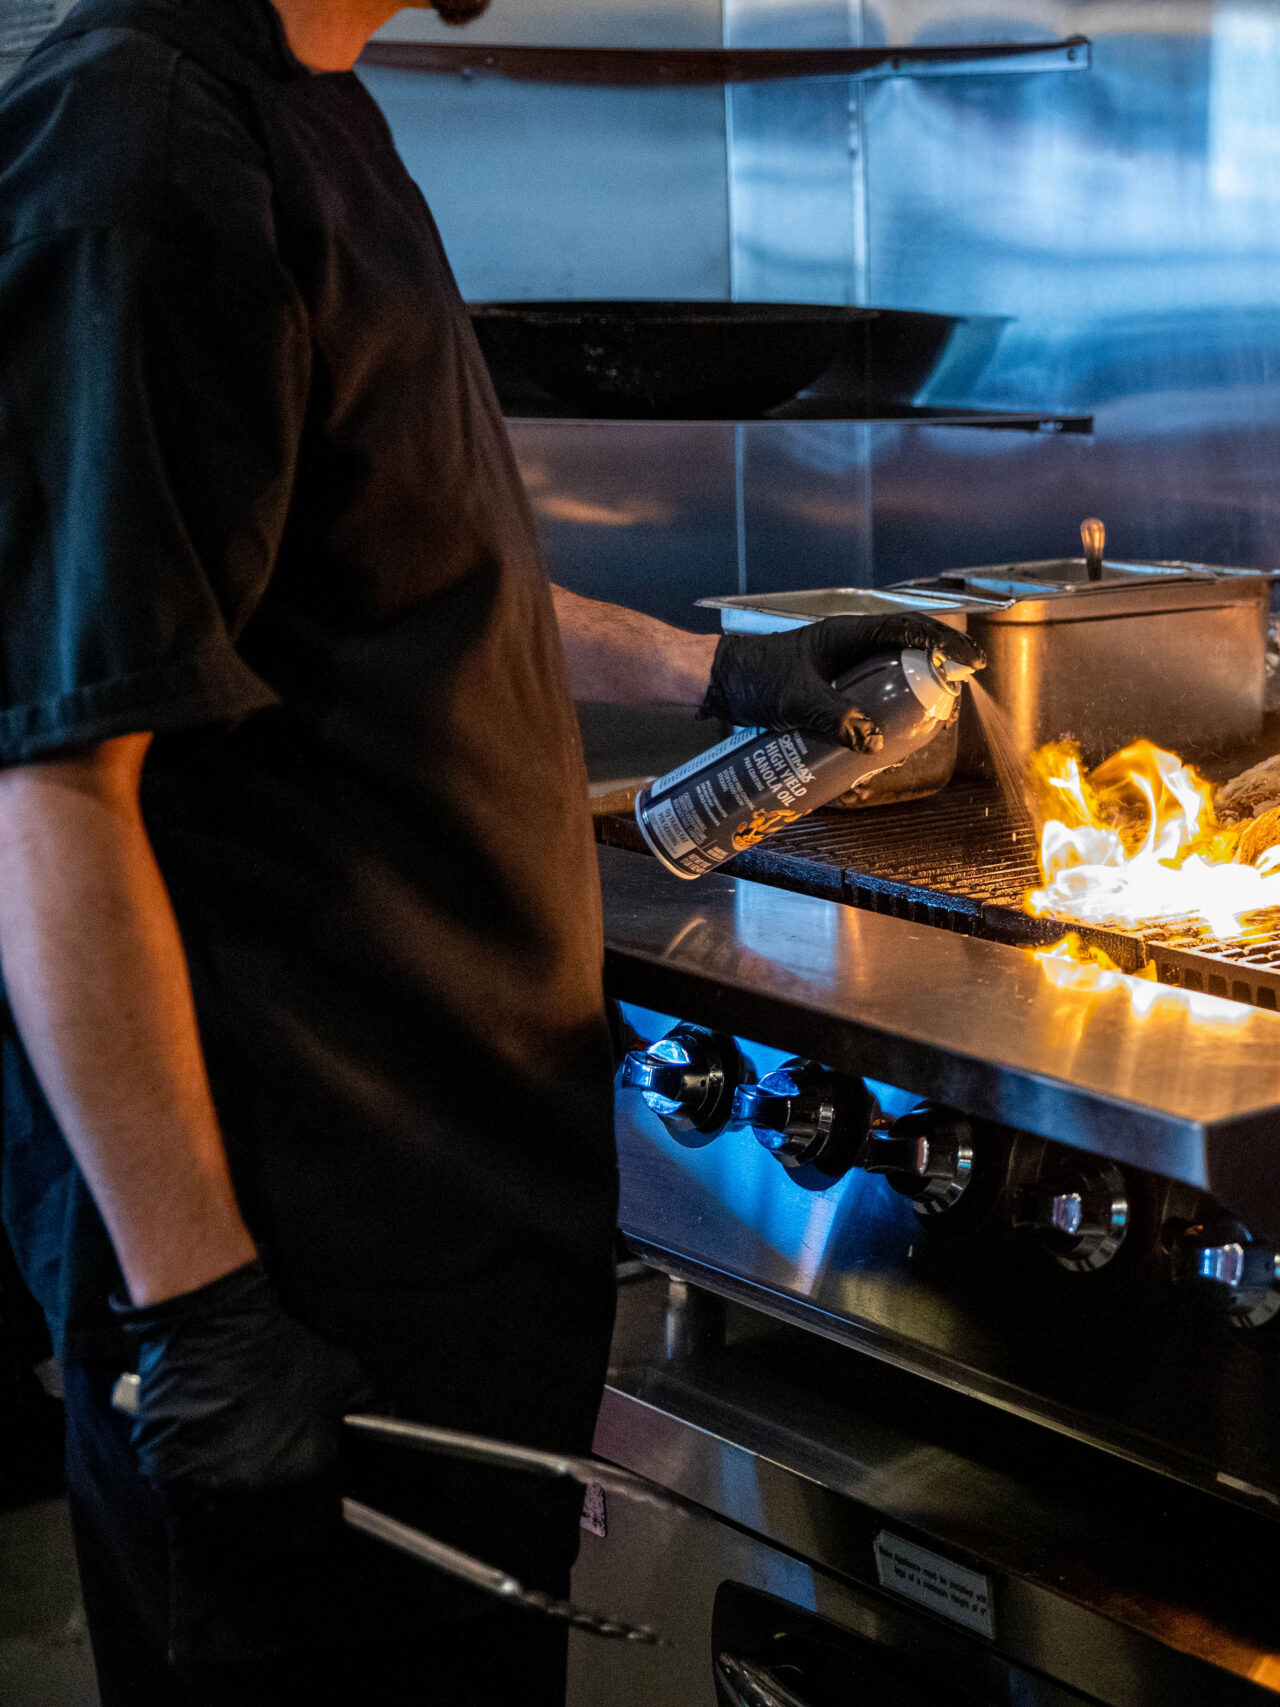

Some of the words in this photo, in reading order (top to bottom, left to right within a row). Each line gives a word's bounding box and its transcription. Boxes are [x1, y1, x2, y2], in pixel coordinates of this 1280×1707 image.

[743, 756, 751, 768] PAN
[747, 767, 764, 791] COATING
[751, 748, 782, 793] CANOLA
[775, 789, 795, 807] OIL
[764, 740, 787, 771] HIGH
[780, 767, 807, 798] YIELD
[780, 733, 816, 782] OPTIMAX
